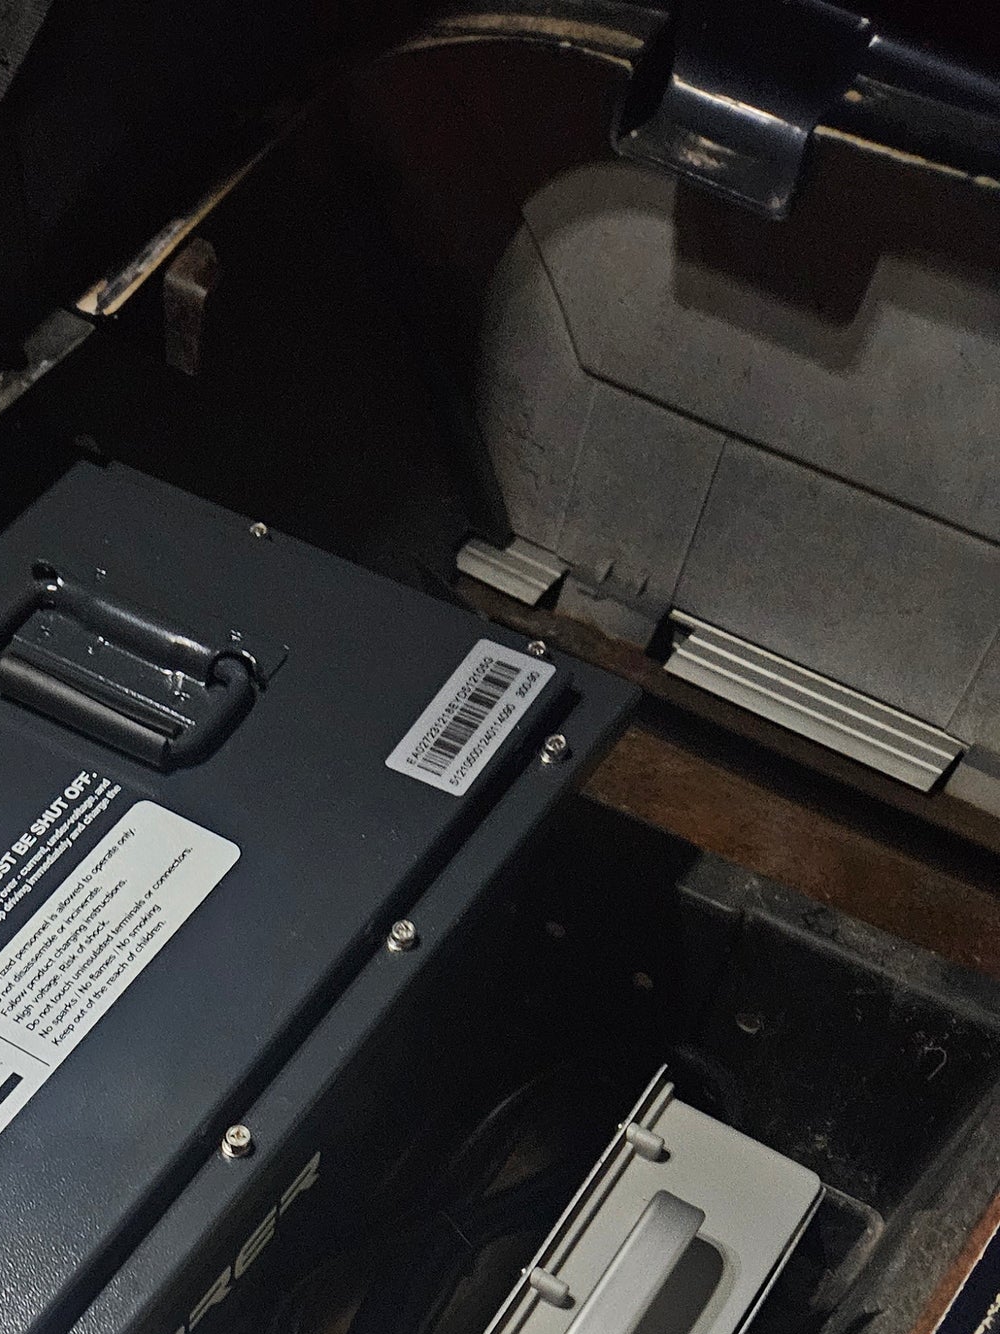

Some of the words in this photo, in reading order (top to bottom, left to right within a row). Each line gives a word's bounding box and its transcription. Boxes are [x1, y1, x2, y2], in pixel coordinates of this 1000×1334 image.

[3, 883, 32, 912] driving
[25, 837, 73, 887] immediately
[69, 821, 86, 841] and
[83, 797, 110, 825] charge
[105, 784, 122, 800] the
[11, 832, 38, 856] BE
[30, 796, 69, 836] SHUT
[64, 770, 98, 800] OFF.
[19, 846, 51, 877] current,
[46, 795, 99, 847] under-voltage,
[94, 777, 111, 796] and
[0, 982, 15, 997] not
[13, 934, 58, 983] disassemble
[56, 924, 66, 935] or
[64, 886, 103, 925] incinerate.
[0, 988, 28, 1017] Follow
[26, 958, 56, 991] product
[54, 923, 88, 959] charging
[84, 879, 128, 924] instructions.
[14, 919, 51, 961] personnel
[49, 914, 58, 922] is
[56, 881, 85, 913] allowed
[81, 874, 93, 883] to
[91, 845, 119, 875] operate
[117, 826, 139, 846] only.
[25, 1018, 40, 1032] Do
[38, 1003, 54, 1019] not
[49, 980, 74, 1004] touch
[72, 933, 114, 981] uninsulated
[110, 900, 146, 935] terminals
[144, 889, 154, 900] or
[152, 847, 193, 890] connectors.
[12, 1004, 35, 1024] High
[32, 973, 63, 1003] voltage.
[58, 954, 78, 973] Risk
[76, 943, 86, 954] of
[84, 920, 110, 944] shock.
[38, 1025, 54, 1039] No
[51, 998, 78, 1026] sparks
[77, 981, 93, 994] No
[88, 954, 117, 982] flames
[115, 938, 131, 951] No
[128, 903, 162, 938] smoking
[51, 1023, 75, 1047] Keep
[73, 1008, 88, 1024] out
[86, 997, 96, 1009] of
[92, 985, 108, 1000] the
[106, 962, 129, 986] reach
[127, 951, 137, 962] of
[135, 921, 165, 953] children.
